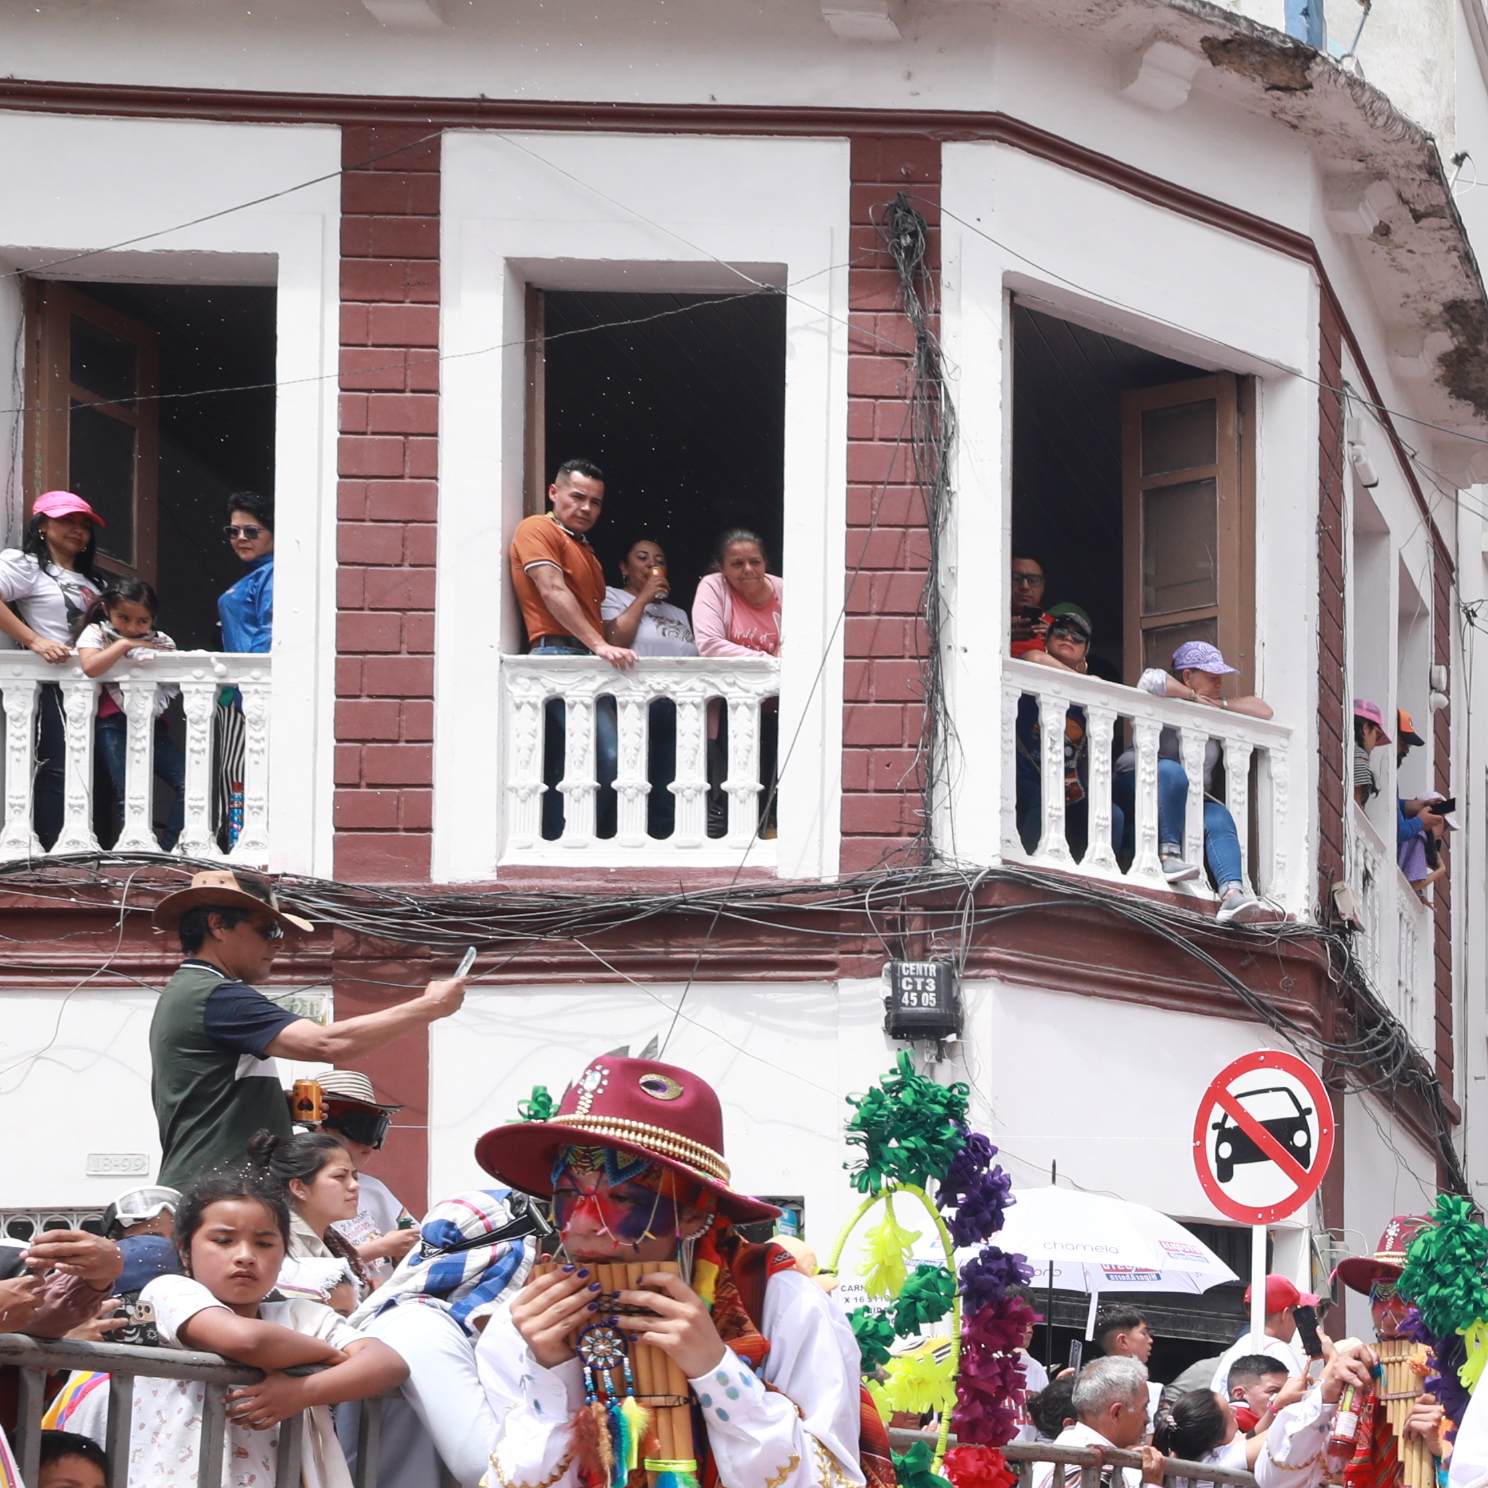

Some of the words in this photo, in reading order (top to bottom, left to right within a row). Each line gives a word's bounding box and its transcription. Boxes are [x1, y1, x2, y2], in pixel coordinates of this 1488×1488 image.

[901, 963, 937, 977] CENTR
[901, 977, 937, 992] CT3
[901, 991, 918, 1007] 45
[921, 992, 937, 1007] 05
[1043, 1241, 1119, 1255] chamela
